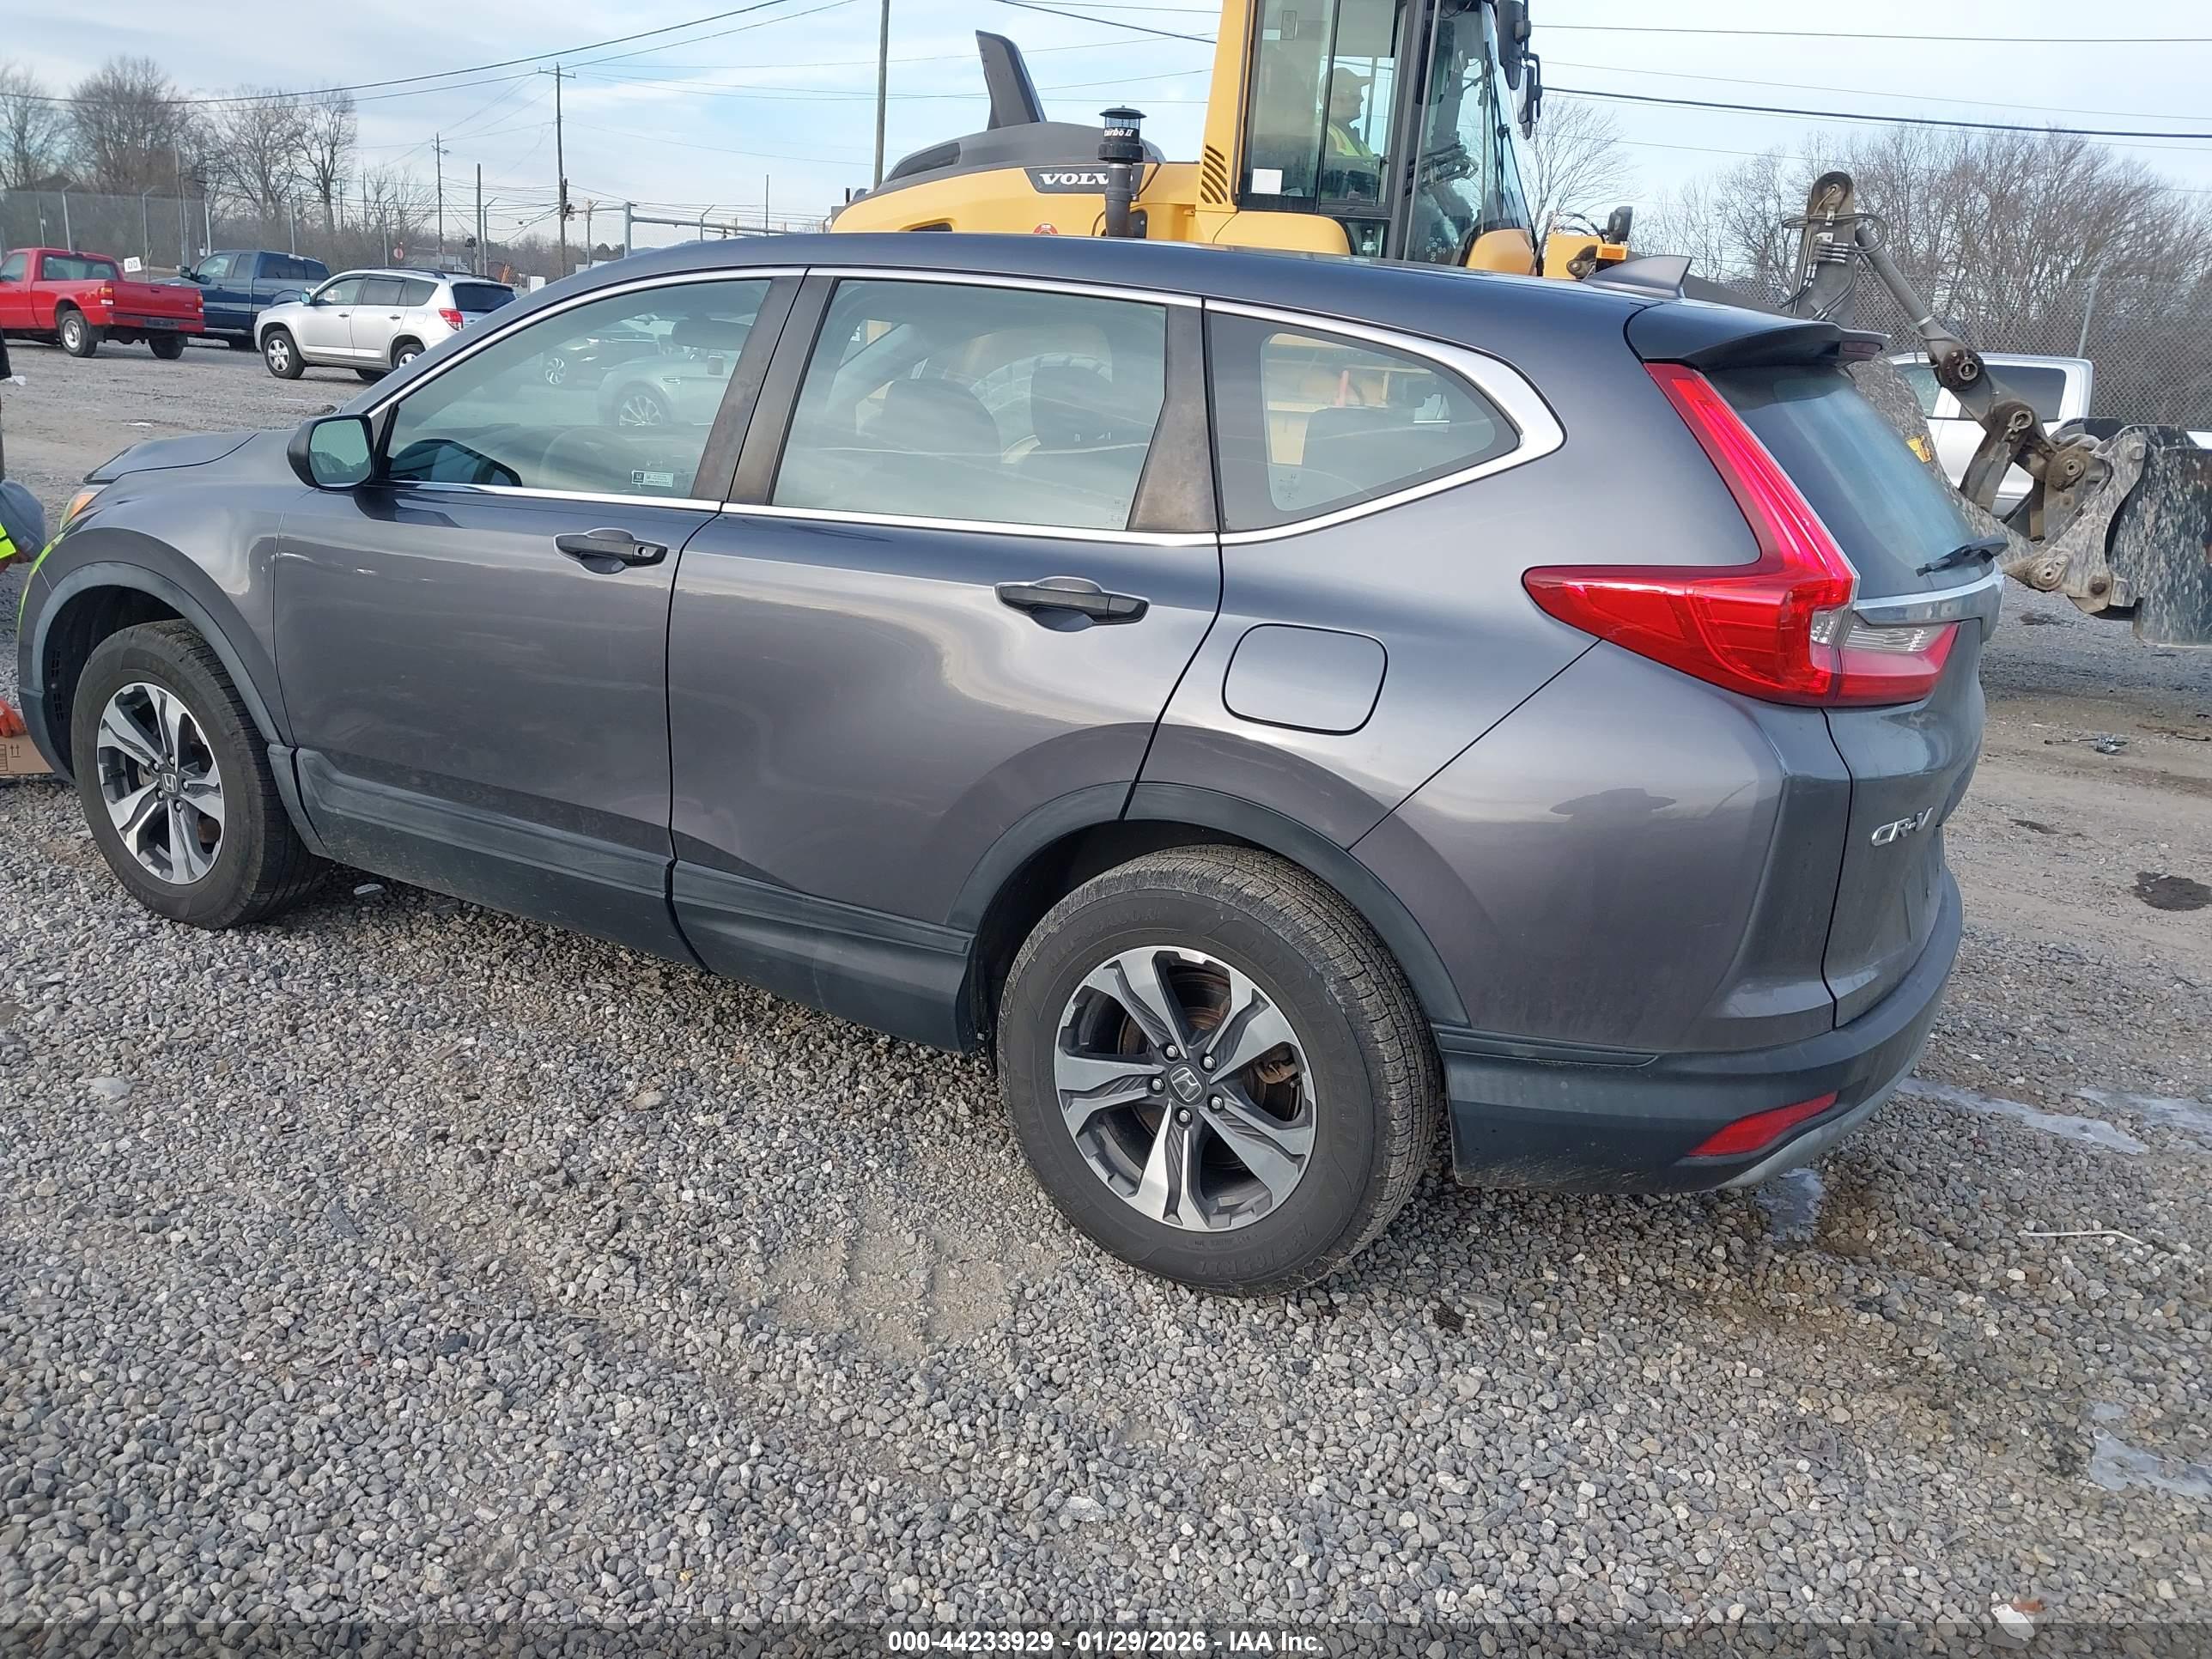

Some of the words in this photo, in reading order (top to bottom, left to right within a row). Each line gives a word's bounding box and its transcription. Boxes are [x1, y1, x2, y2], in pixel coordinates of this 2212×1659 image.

[1103, 128, 1125, 137] turbo
[1039, 173, 1133, 185] VOLV
[1871, 806, 1934, 847] CR-V
